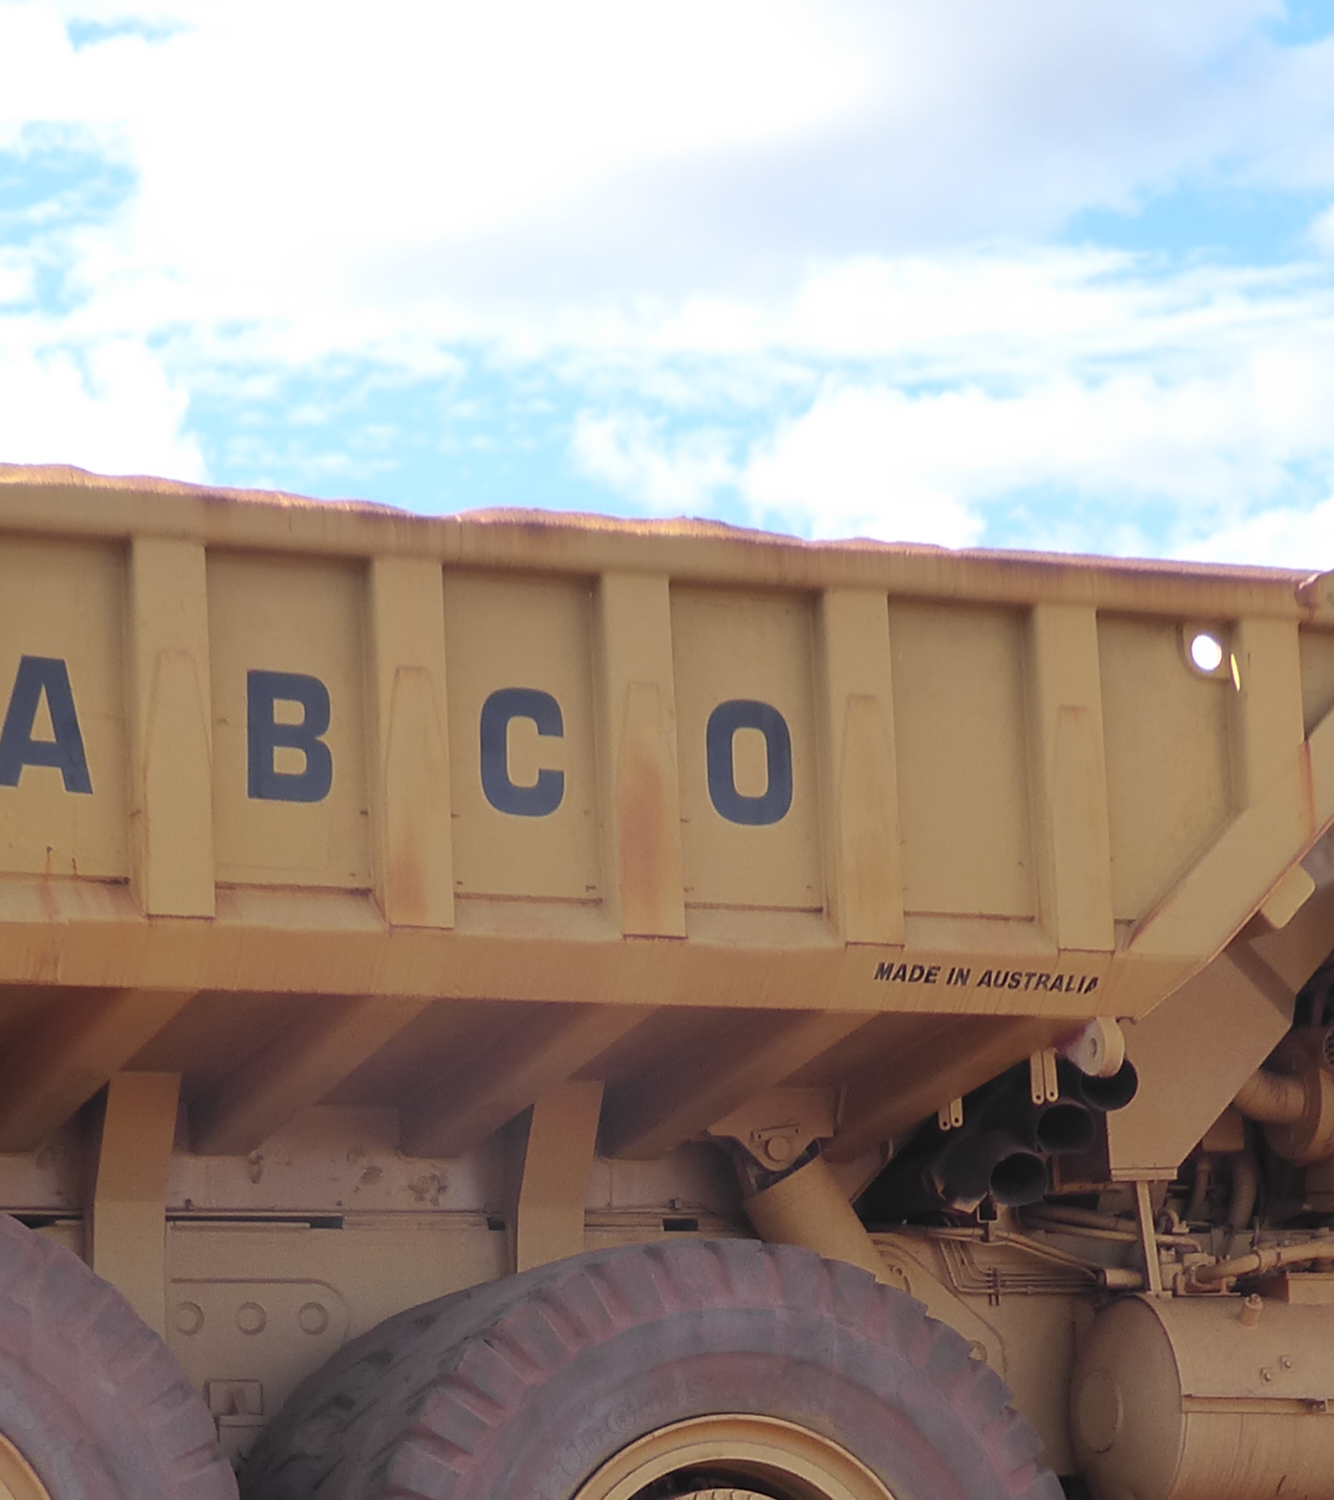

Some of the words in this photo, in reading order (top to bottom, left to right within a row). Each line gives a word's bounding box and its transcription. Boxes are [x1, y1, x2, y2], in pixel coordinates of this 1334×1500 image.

[873, 962, 941, 985] MADE
[945, 967, 971, 987] IN
[976, 969, 1100, 995] AUSTRALIA
